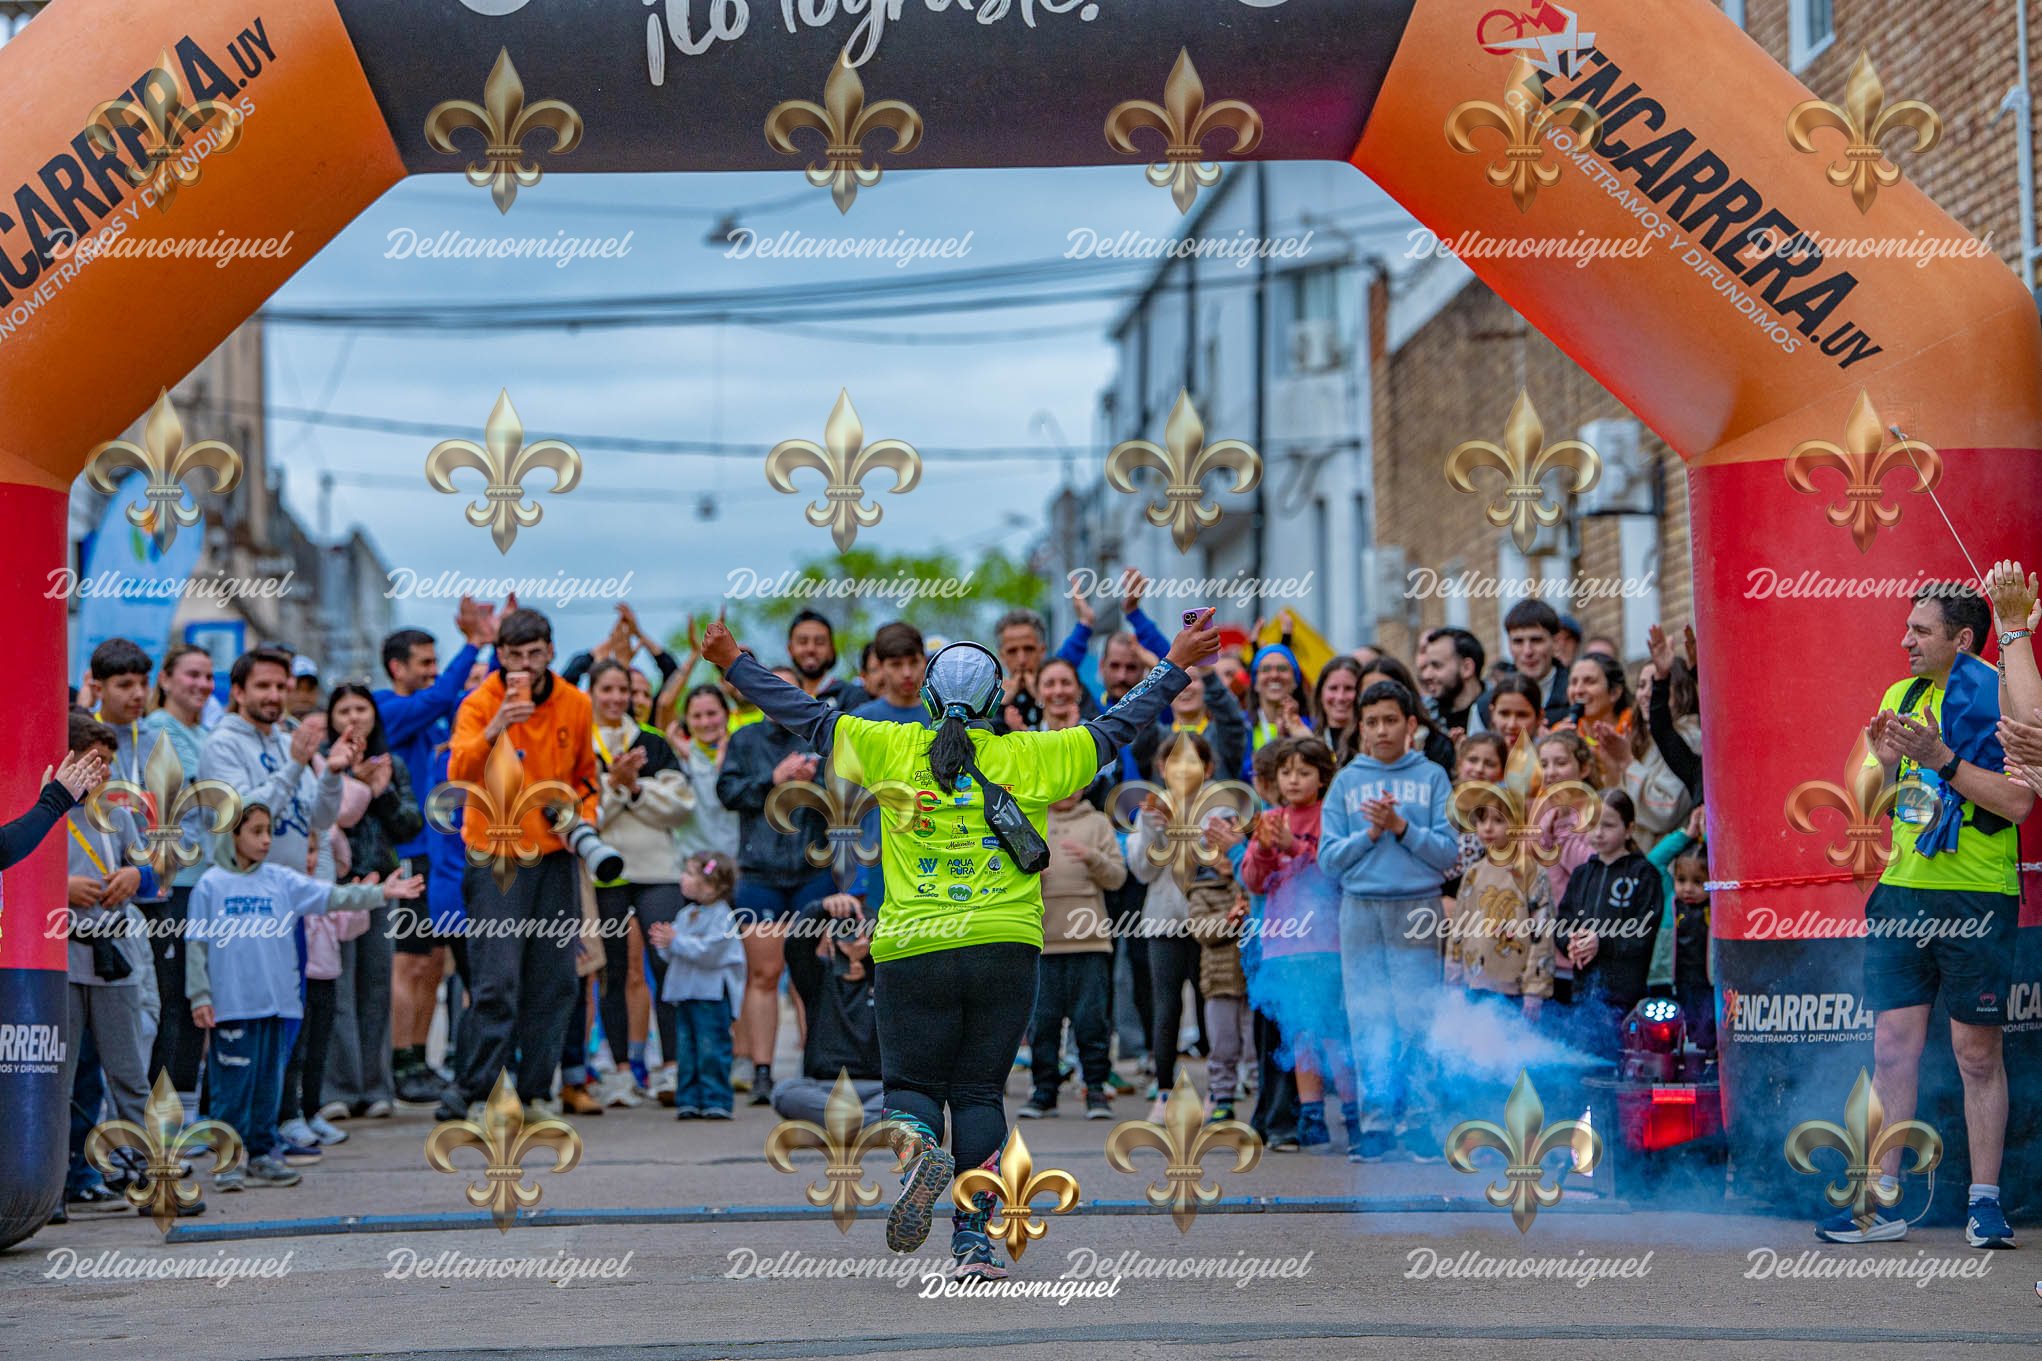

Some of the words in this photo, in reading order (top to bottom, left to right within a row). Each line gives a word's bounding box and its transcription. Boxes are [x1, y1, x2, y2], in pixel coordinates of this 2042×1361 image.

[0, 17, 277, 308] CARRERA.UY
[0, 217, 128, 343] NOMETRAMOS
[124, 199, 141, 221] Y
[139, 95, 256, 209] DIFUNDIMOS
[1503, 89, 1671, 240] CRONOMETRAMOS
[1669, 231, 1688, 250] Y
[1681, 247, 1803, 355] DIFUNDIMOS
[1521, 46, 1884, 370] ENCARRERA.UY
[947, 858, 974, 867] AQUA
[950, 867, 976, 876] PURA
[14, 1064, 20, 1073] Y
[1733, 1032, 1799, 1044] CRONOMETRAMOS
[1800, 1033, 1807, 1043] Y
[1808, 1032, 1874, 1043] DIFUNDIMOS
